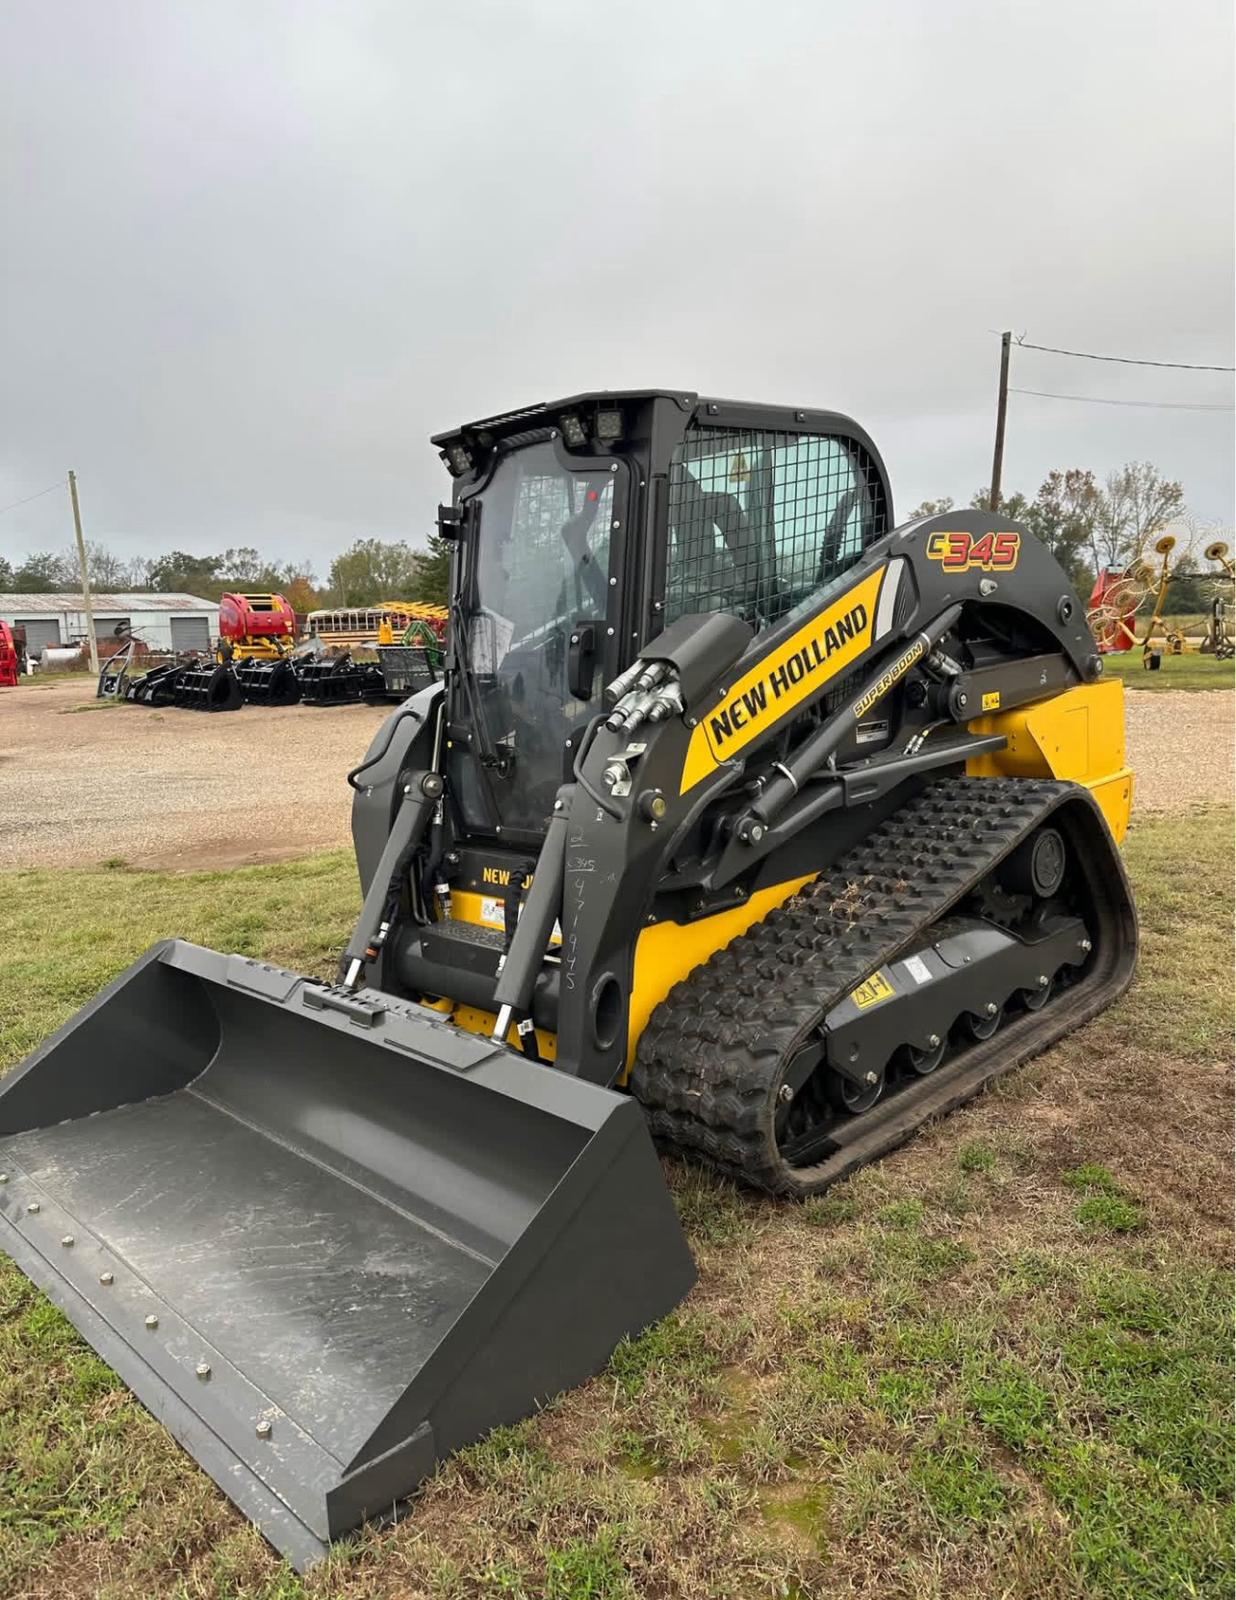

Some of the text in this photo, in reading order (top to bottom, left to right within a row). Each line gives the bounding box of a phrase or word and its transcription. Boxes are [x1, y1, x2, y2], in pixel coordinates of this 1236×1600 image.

[927, 532, 1020, 572] C345
[710, 604, 867, 745] NEW HOLLAND
[853, 674, 893, 718] SUPER
[890, 642, 922, 681] BOOM
[483, 867, 510, 886] NEW
